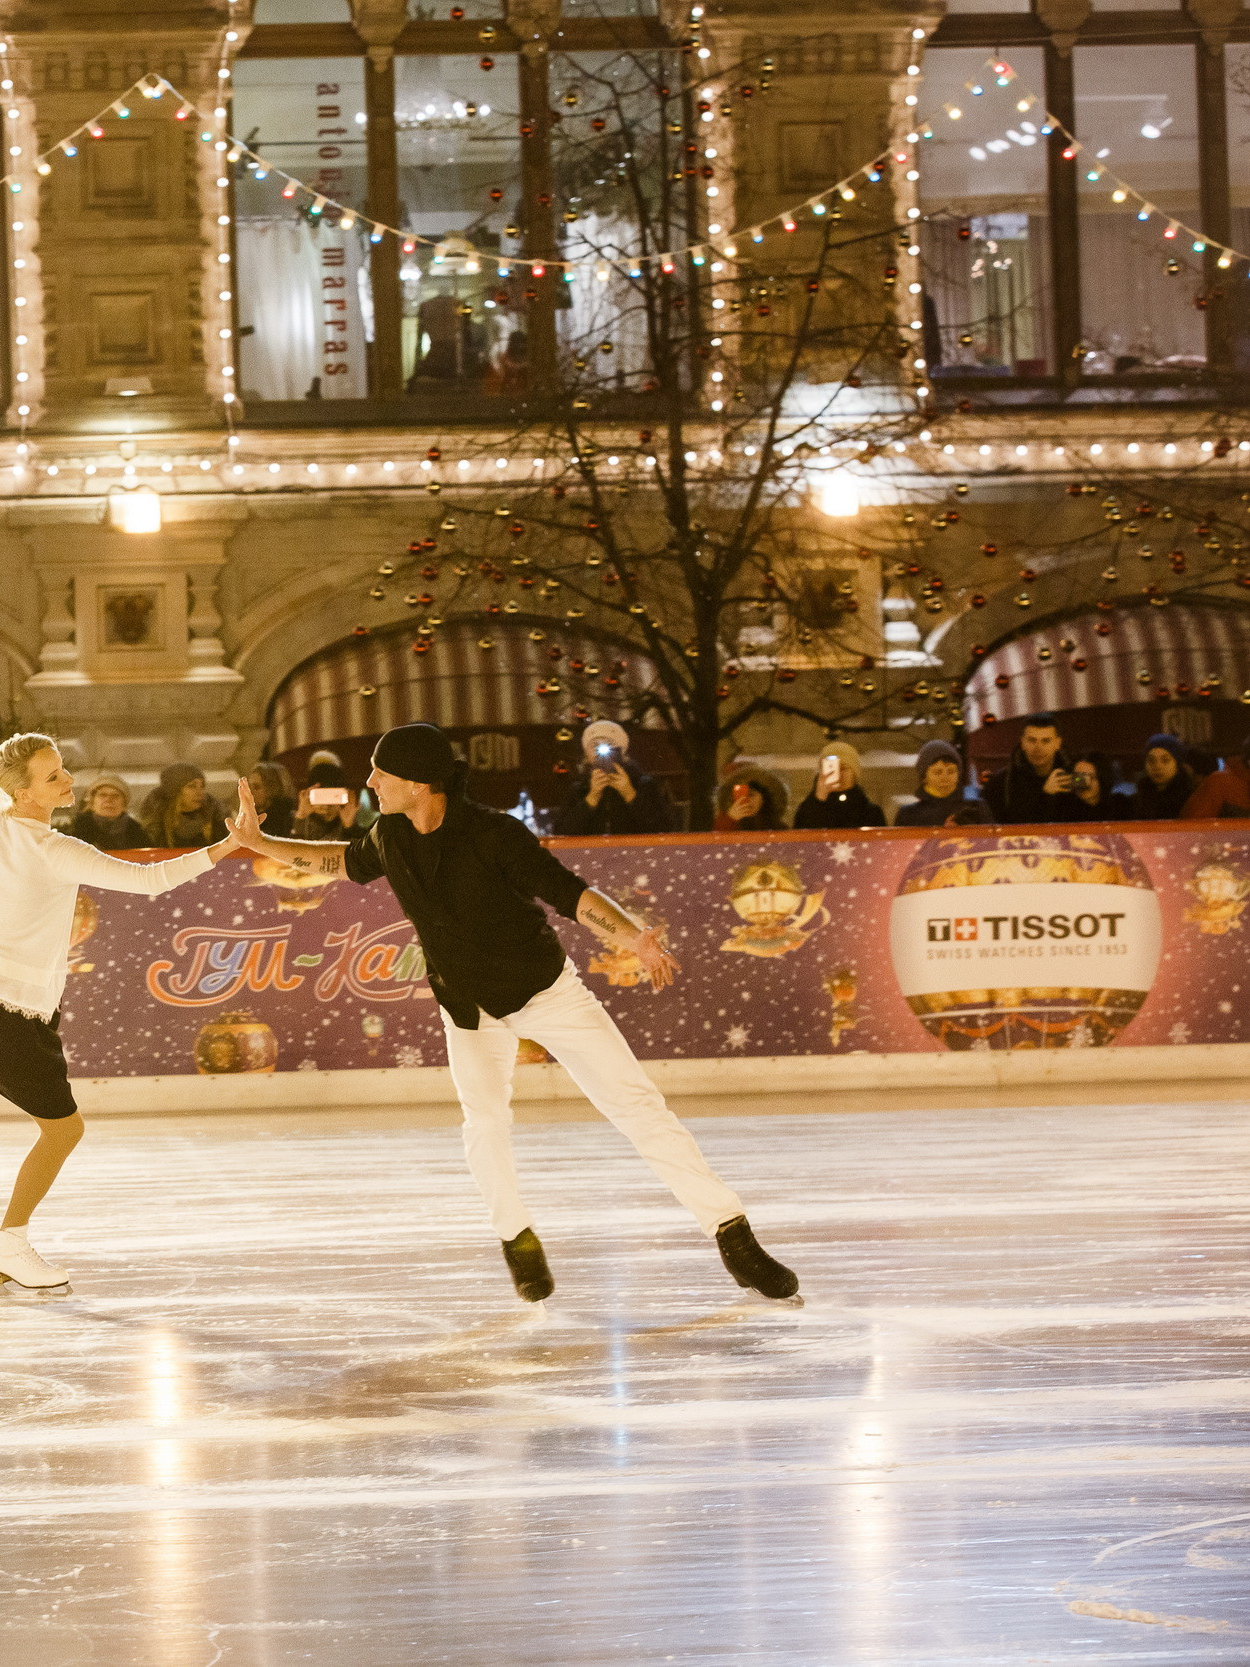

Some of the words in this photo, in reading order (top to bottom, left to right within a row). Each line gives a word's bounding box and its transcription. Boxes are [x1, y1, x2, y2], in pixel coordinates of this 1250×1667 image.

[322, 247, 348, 376] marras
[983, 913, 1126, 940] TISSOT
[927, 949, 972, 960] SWISS
[979, 946, 1044, 959] WATCHES
[1051, 944, 1091, 957] SINCE
